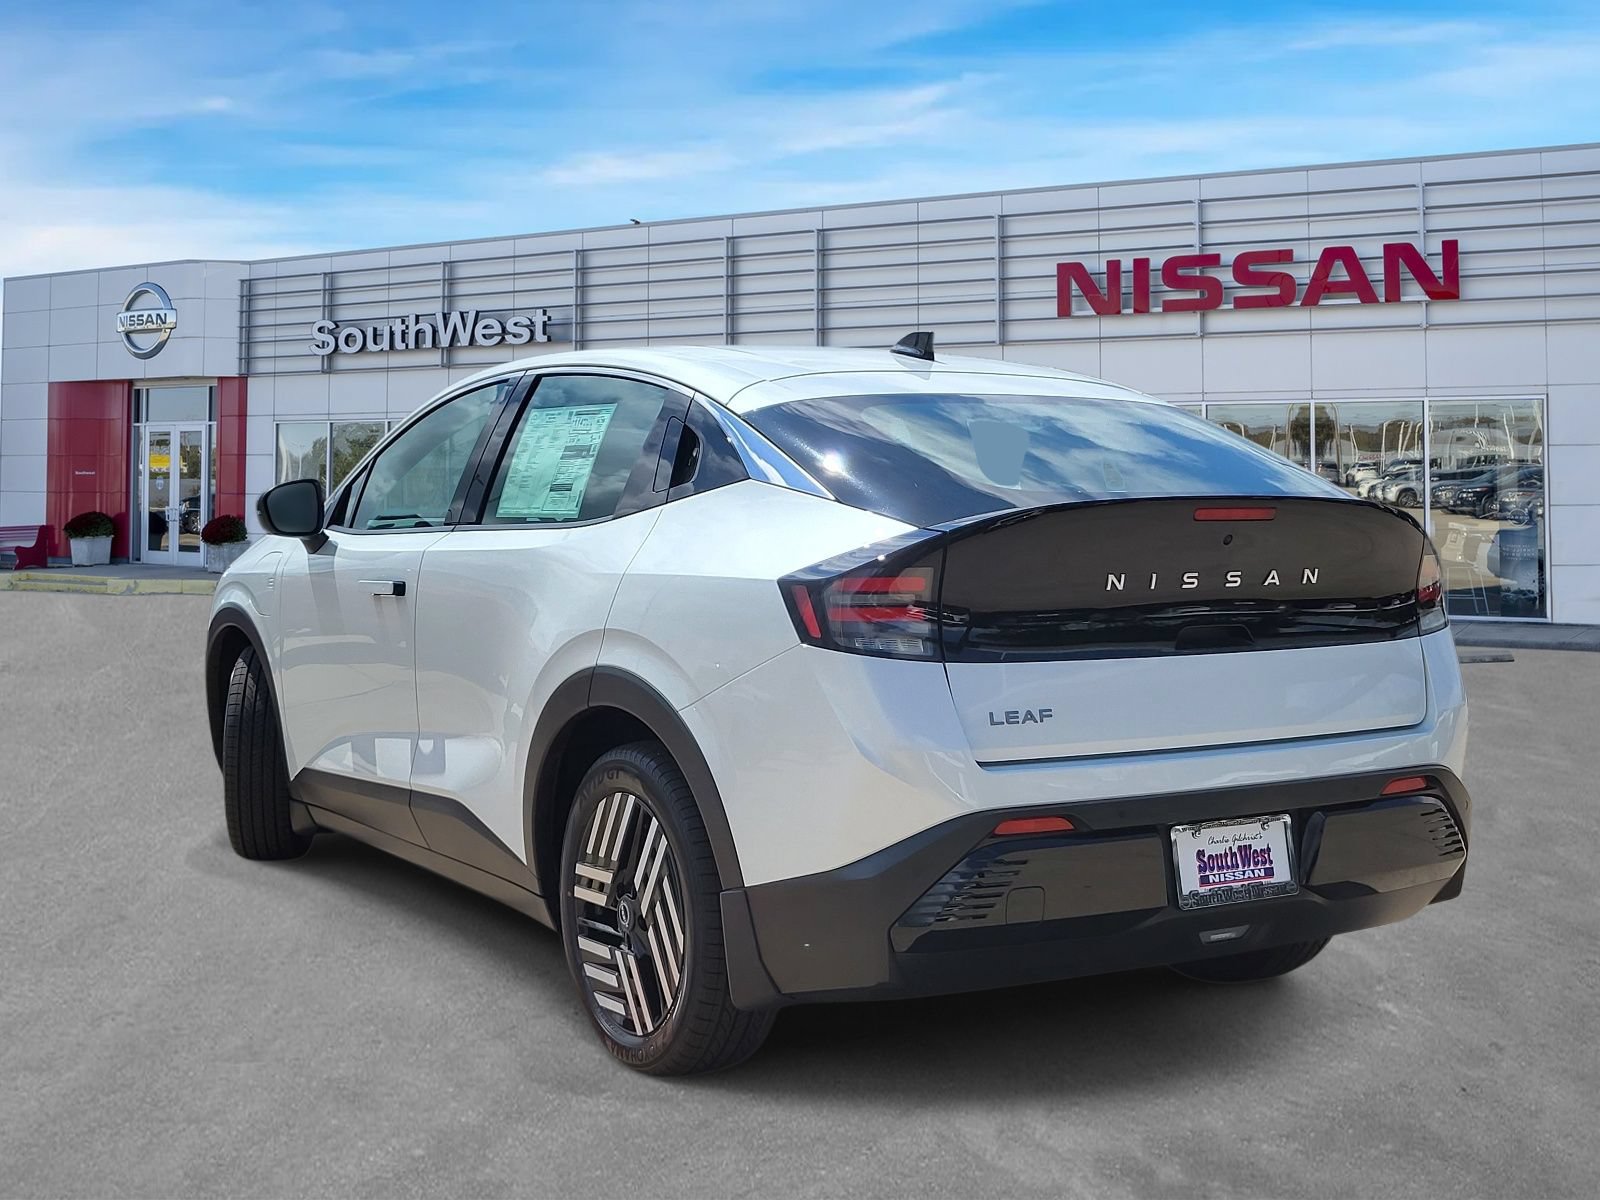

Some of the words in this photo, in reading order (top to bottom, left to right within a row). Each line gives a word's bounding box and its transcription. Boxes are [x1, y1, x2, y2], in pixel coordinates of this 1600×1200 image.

[1056, 239, 1460, 317] NISSAN
[119, 312, 168, 328] NISSAN
[309, 308, 551, 356] SouthWest
[1105, 567, 1319, 591] NISSAN
[988, 708, 1053, 726] LEAF
[1195, 843, 1274, 875] SouthWest
[1208, 868, 1265, 883] NISSAN
